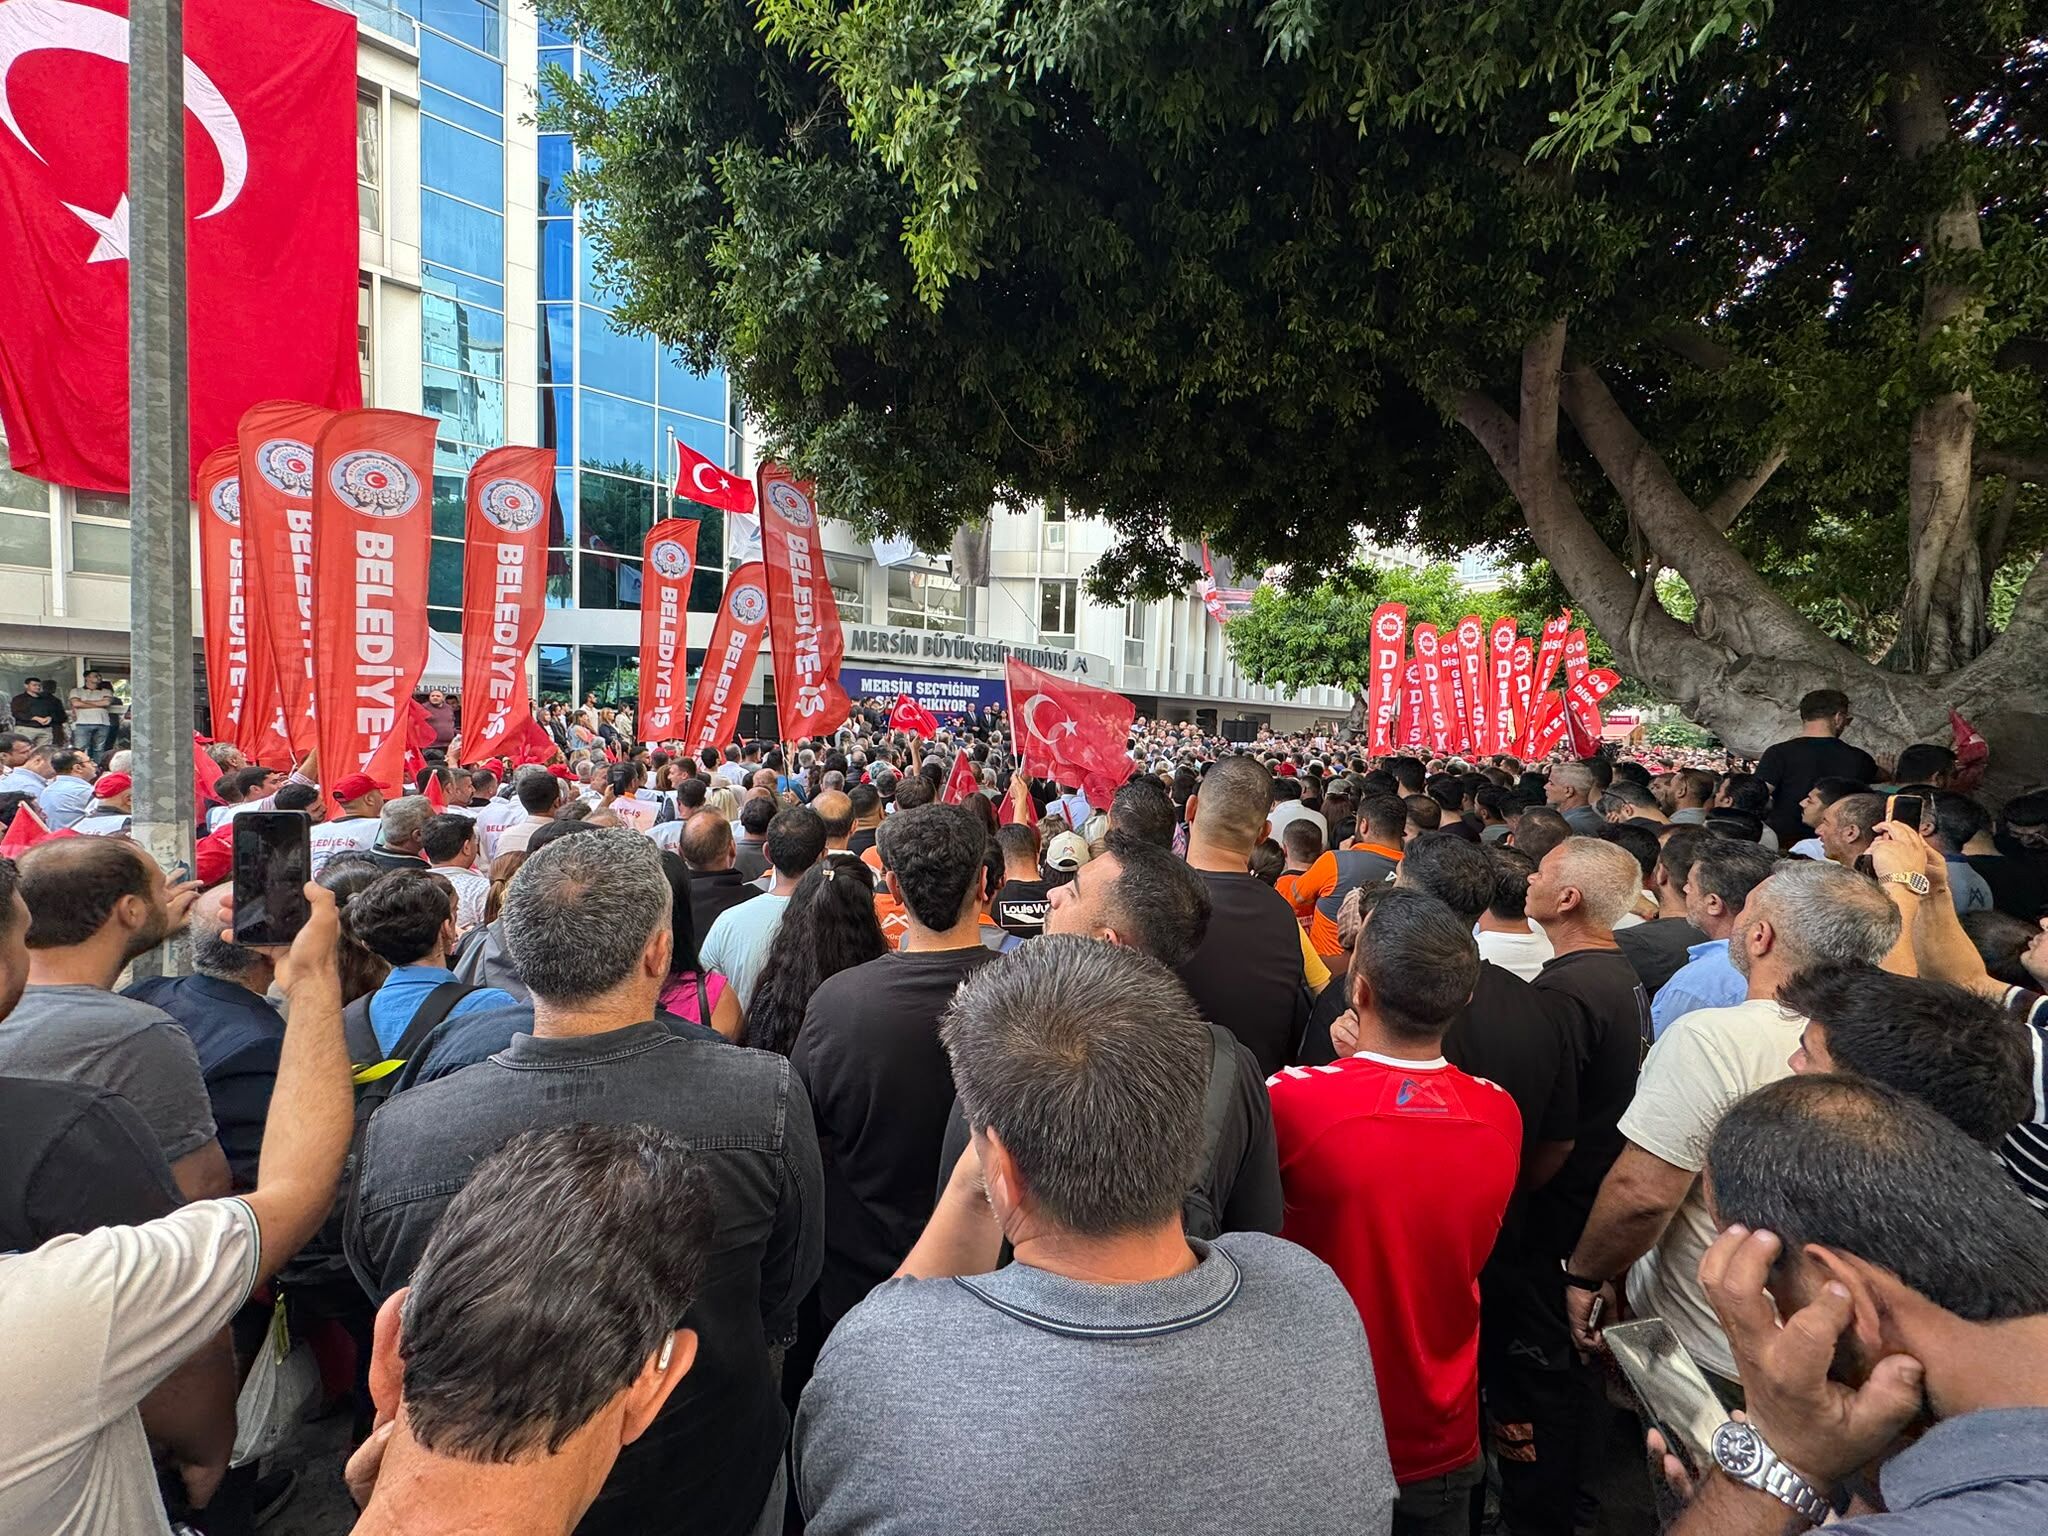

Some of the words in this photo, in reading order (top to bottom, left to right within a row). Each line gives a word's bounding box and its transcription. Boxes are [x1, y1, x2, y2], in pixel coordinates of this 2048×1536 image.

[481, 543, 524, 740] BELEDİYE-İŞ
[651, 585, 678, 728] BELEDİYE-İŞ
[786, 531, 827, 718] BELEDİYE-İŞ
[851, 629, 919, 656] MERSİN
[922, 632, 1011, 664] BÜYÜKŞEHİR
[861, 678, 913, 694] MERSİN
[916, 681, 979, 698] SEÇTİĞİNE
